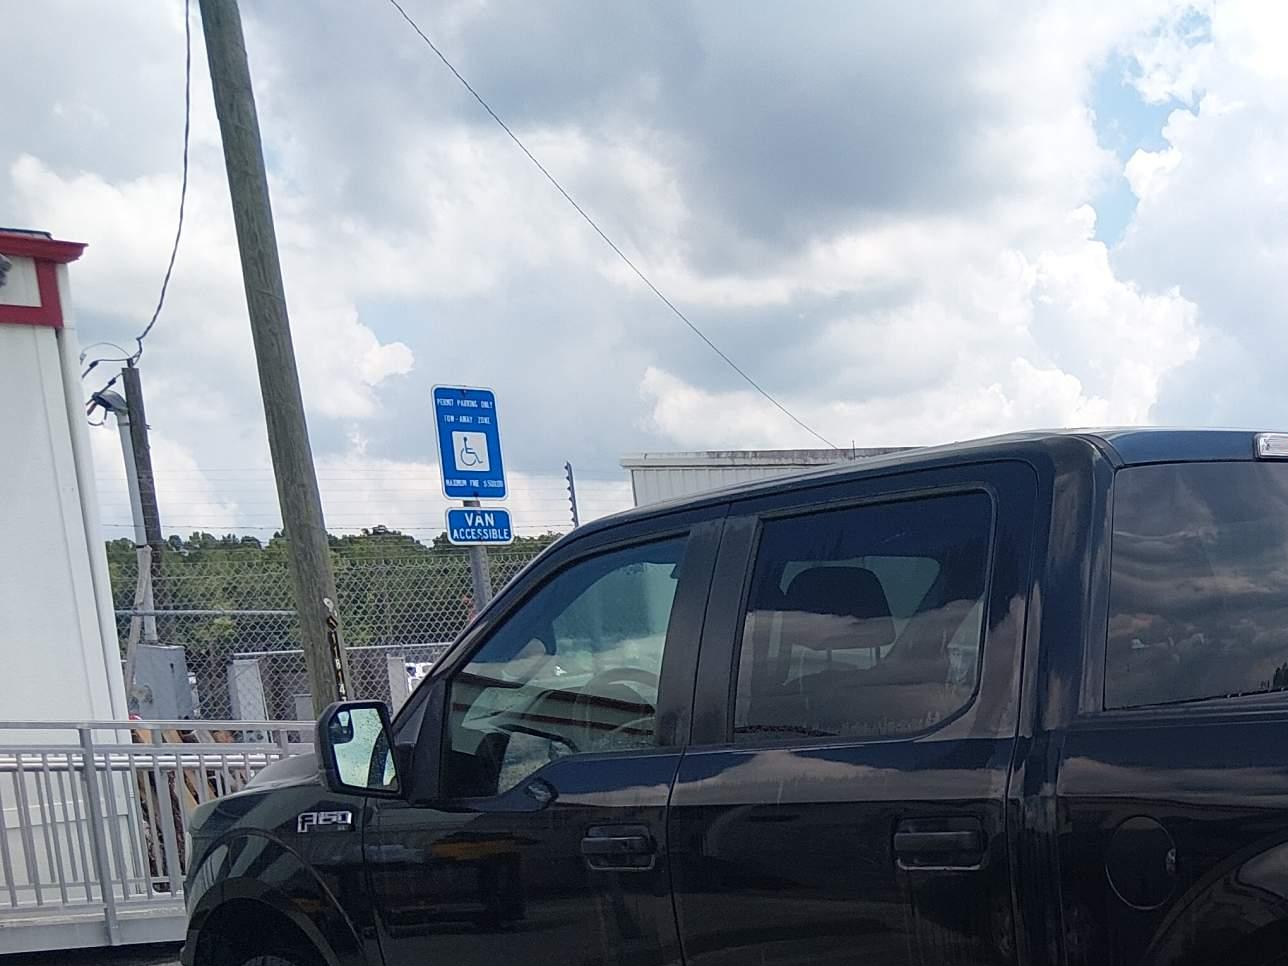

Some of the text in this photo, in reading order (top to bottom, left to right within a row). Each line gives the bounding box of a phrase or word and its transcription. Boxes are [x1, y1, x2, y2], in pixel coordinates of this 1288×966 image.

[456, 399, 478, 408] PARKING
[480, 400, 493, 409] ONLY
[464, 512, 495, 527] VAN
[453, 528, 510, 540] ACCESSIBLE
